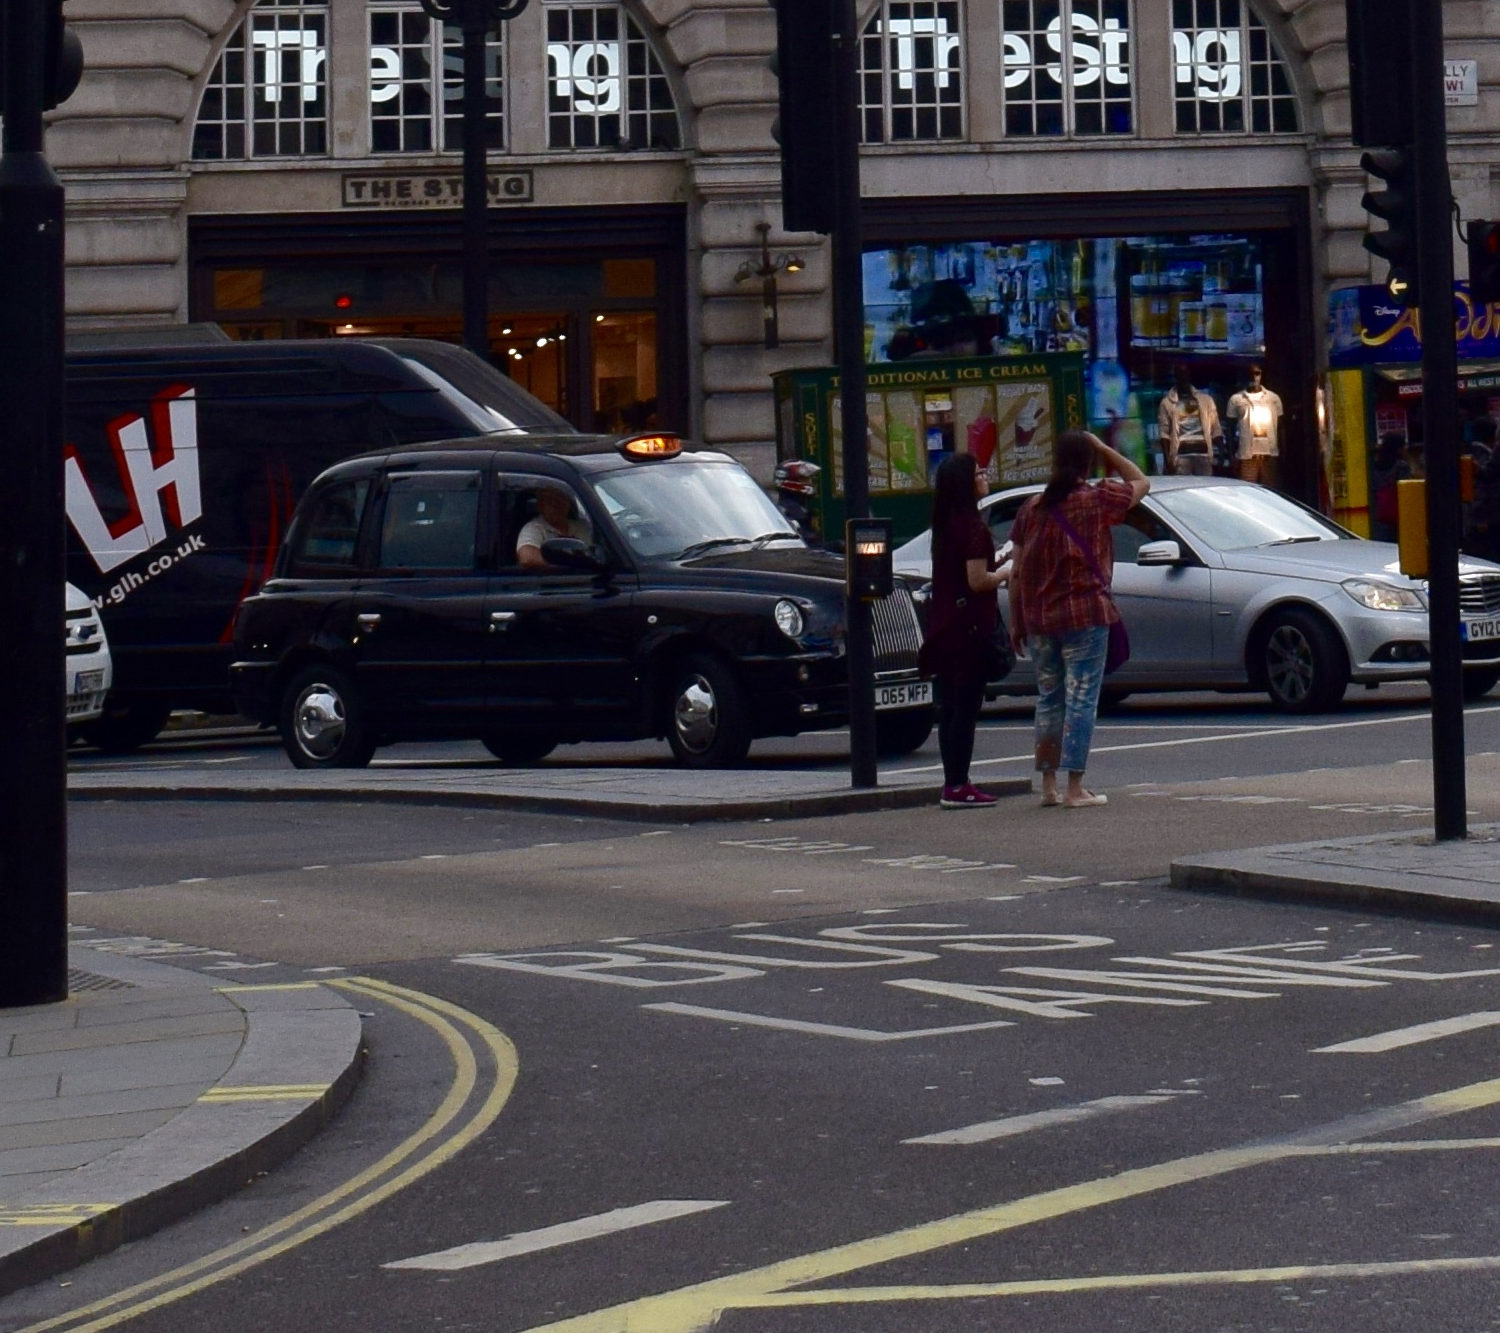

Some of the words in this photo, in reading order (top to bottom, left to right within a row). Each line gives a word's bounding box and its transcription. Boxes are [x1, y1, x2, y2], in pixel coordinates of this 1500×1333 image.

[421, 24, 621, 113] Stng
[1045, 12, 1240, 102] Stng
[1445, 79, 1464, 92] W1
[351, 179, 412, 199] THE
[424, 176, 525, 198] STNG
[1372, 305, 1401, 317] Disney
[830, 369, 950, 388] TDITIONAL
[956, 367, 983, 380] ICE
[989, 364, 1046, 378] CREAM
[805, 412, 817, 456] SOFT
[65, 387, 203, 574] LH
[856, 541, 886, 555] WAIT
[90, 534, 207, 611] w.glh.co.uk
[1470, 621, 1495, 638] GY12
[907, 684, 928, 703] MFP
[451, 921, 1115, 990] BUS
